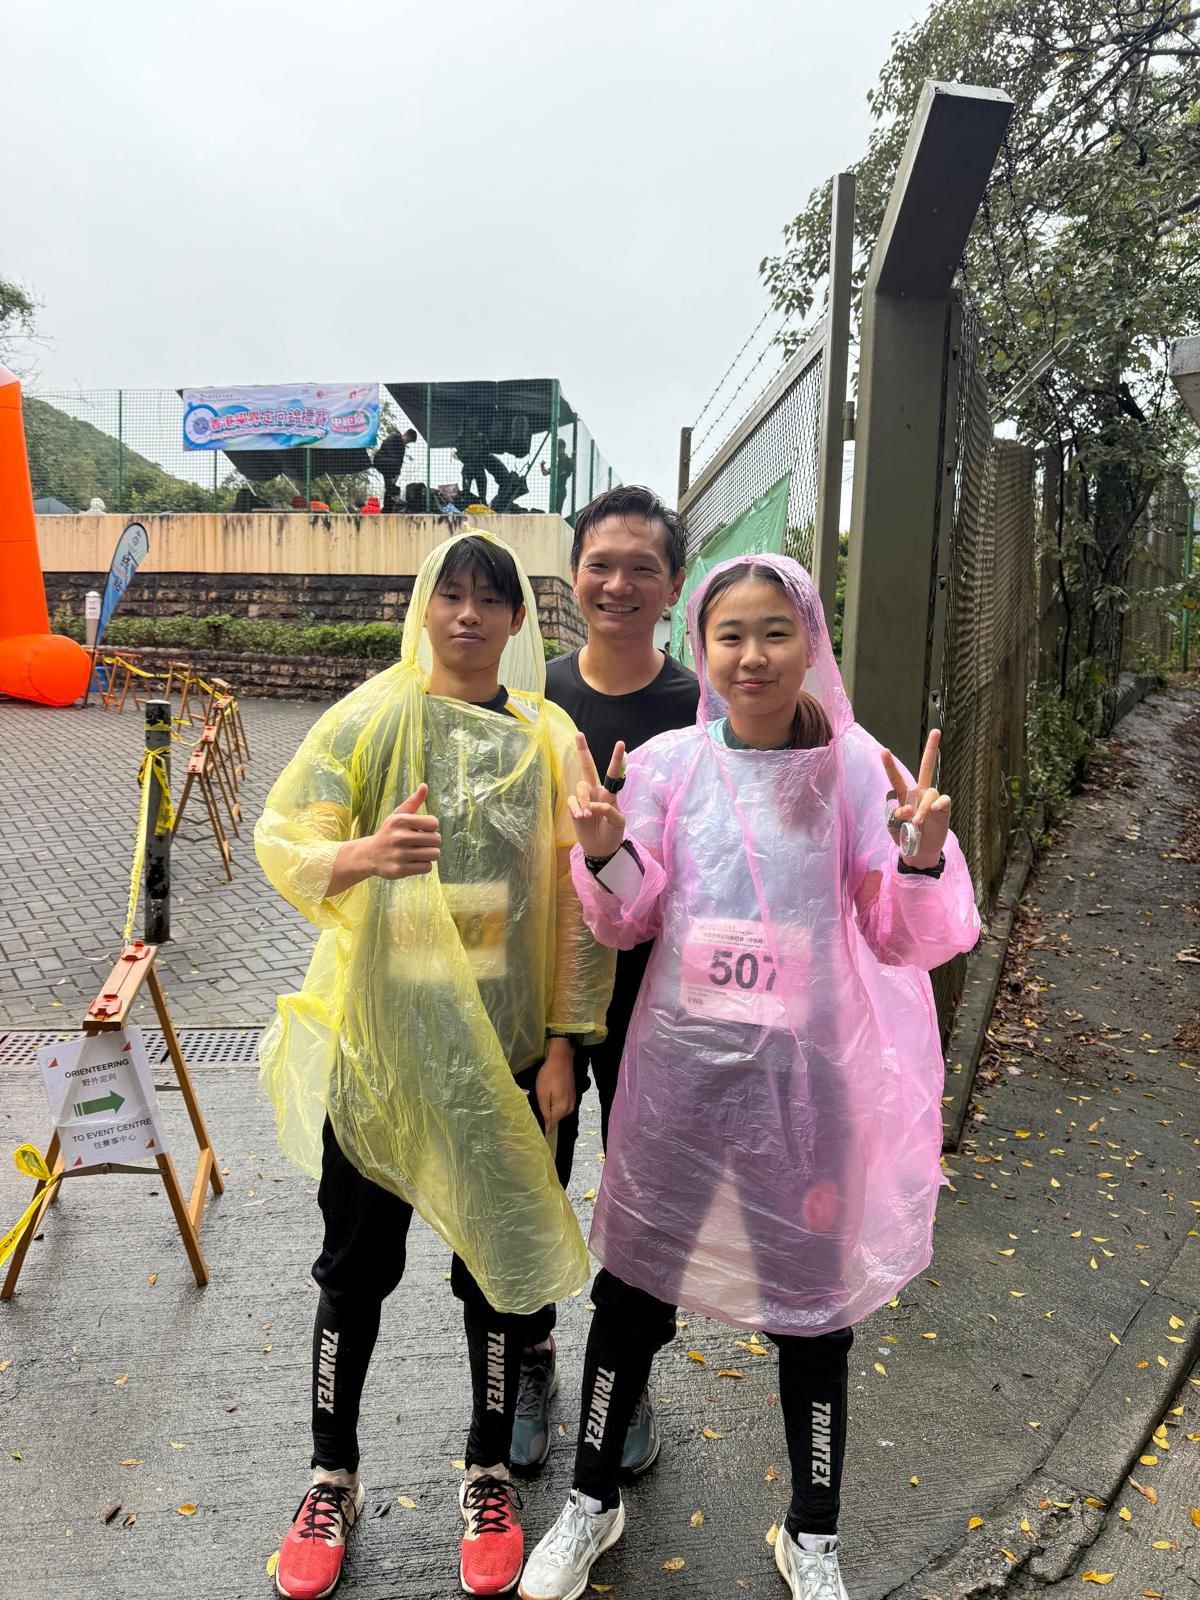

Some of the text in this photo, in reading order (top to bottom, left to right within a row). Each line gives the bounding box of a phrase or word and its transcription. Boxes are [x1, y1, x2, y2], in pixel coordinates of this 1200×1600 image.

[709, 950, 779, 991] 507
[65, 1058, 129, 1078] ORIENTEERING
[82, 1073, 117, 1087] 野外定向
[72, 1117, 153, 1143] TO EVENT CENTRE
[94, 1134, 136, 1149] 往賽事中心
[317, 1328, 340, 1415] TRIMTEX
[486, 1331, 505, 1415] TRIMTEX
[584, 1366, 616, 1452] TRIMTEX
[811, 1401, 831, 1488] TRIMTEX
